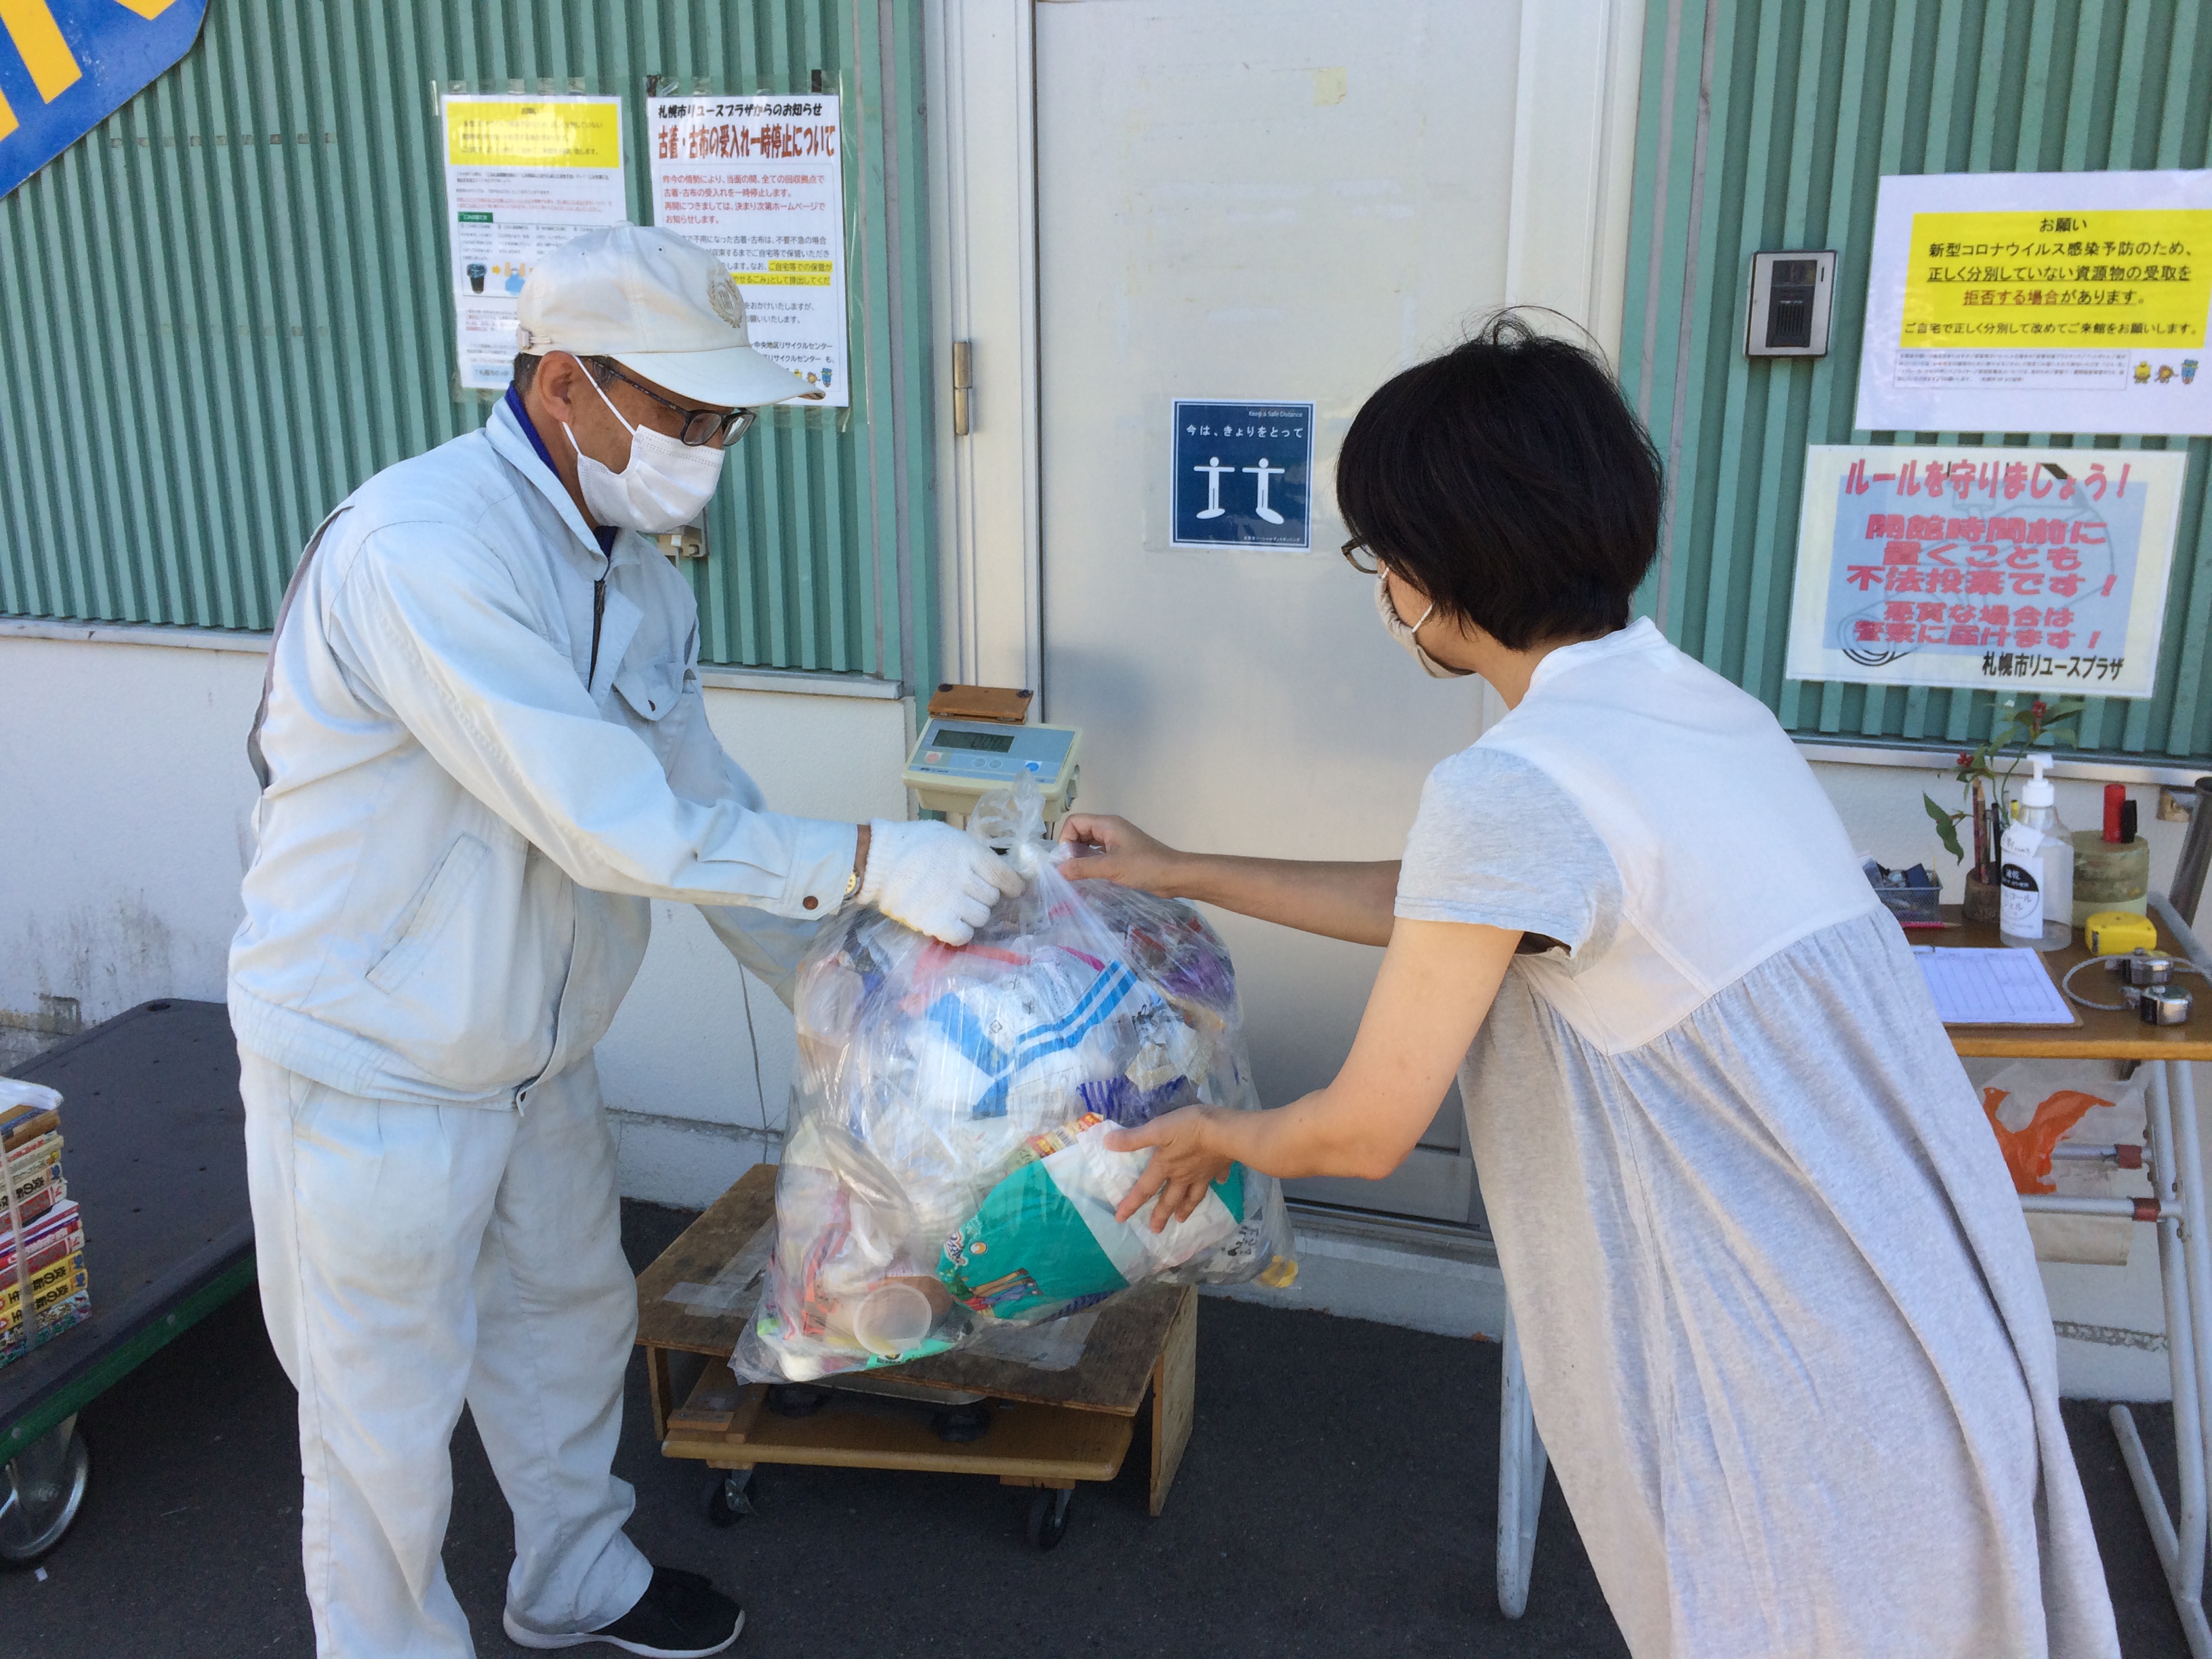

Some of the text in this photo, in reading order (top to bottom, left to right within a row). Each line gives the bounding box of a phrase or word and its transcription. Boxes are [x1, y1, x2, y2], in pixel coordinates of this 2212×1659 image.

[658, 103, 823, 119] 札幌市リユースプラザからのお知らせ
[658, 123, 836, 159] 古着・古布の受入れ一時停止について
[665, 215, 720, 224] お知らせします。
[2039, 218, 2087, 232] お願い
[1928, 241, 2192, 258] 新型コロナウイルス感染予防のため、
[1927, 265, 2192, 282] 正しく分別していない資源物の受取を
[1963, 289, 2145, 306] 拒否する場合があります。
[1186, 424, 1303, 438] 今は、きょりをとって
[1845, 458, 2131, 502] ルールを守りましょう！
[1865, 514, 2109, 544] 開館時間前に
[1882, 541, 2083, 571] 置くことも
[1883, 600, 2075, 628] 悪質な場合は
[1982, 651, 2125, 681] 札幌市リユースプラザ
